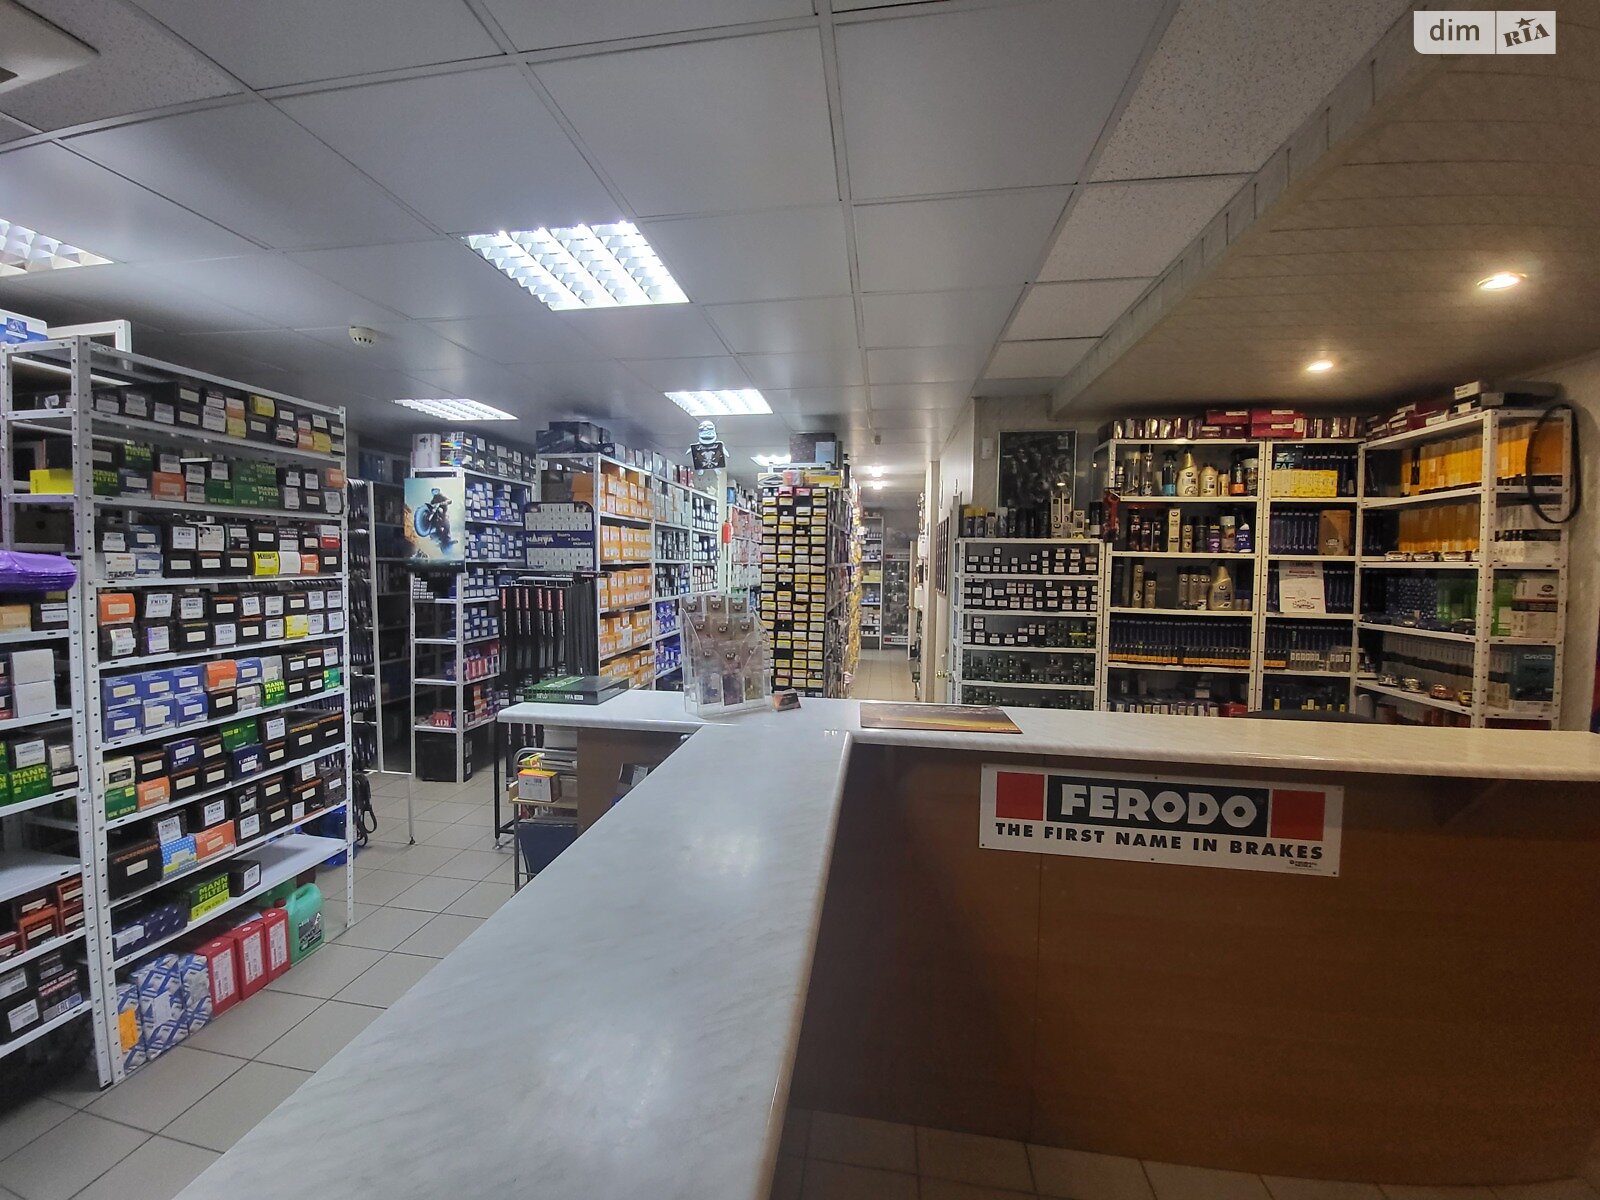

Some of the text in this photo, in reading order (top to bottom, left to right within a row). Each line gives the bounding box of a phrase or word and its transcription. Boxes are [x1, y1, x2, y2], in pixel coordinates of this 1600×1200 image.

[526, 533, 554, 546] NARVA
[265, 685, 285, 694] FILTER
[12, 766, 47, 780] MANN
[12, 773, 48, 787] FILTER
[1061, 783, 1257, 828] FERODO
[995, 822, 1323, 859] THE FIRST NAME IN BRAKES
[199, 875, 228, 896] MANN
[199, 882, 228, 902] FILTER
